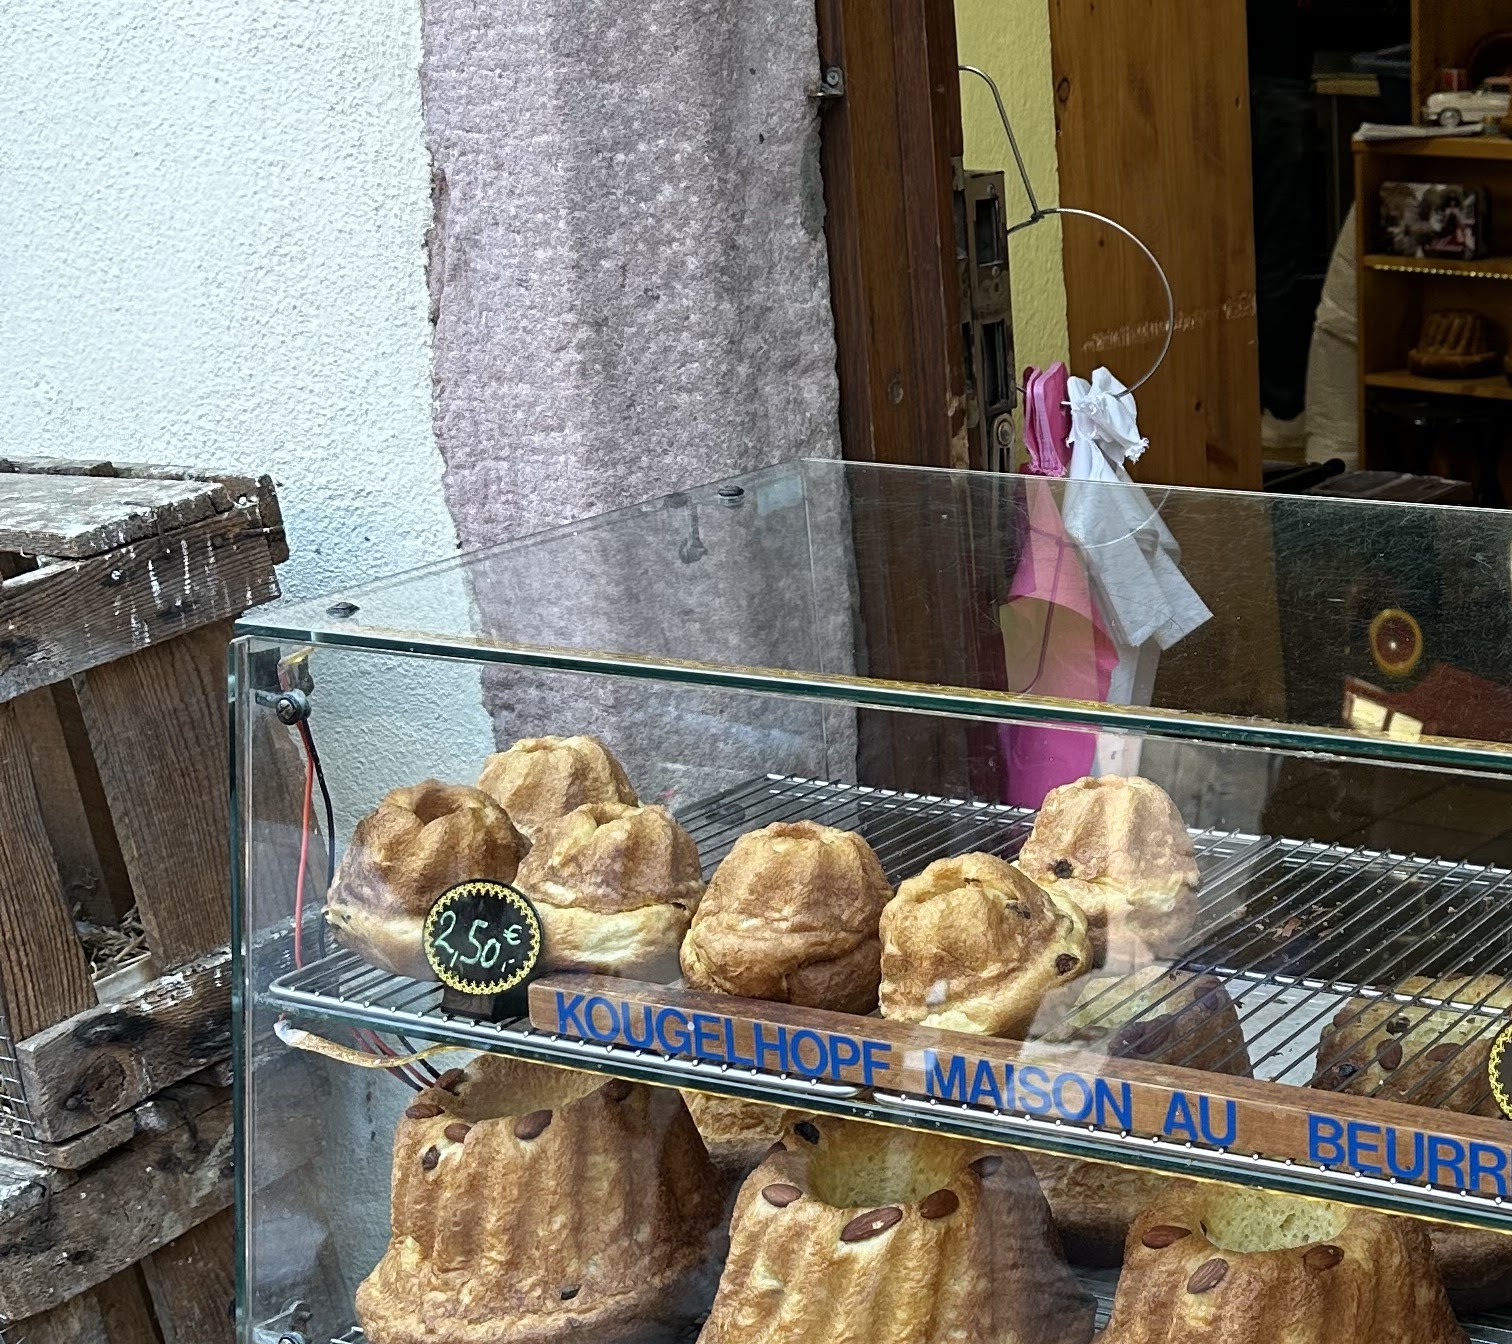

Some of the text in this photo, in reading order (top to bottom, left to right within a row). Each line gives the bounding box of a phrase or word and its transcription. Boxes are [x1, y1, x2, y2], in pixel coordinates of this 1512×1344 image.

[555, 990, 892, 1088] KOUGELHOPF
[923, 1049, 1132, 1132] MAISON
[1161, 1091, 1238, 1150] AU
